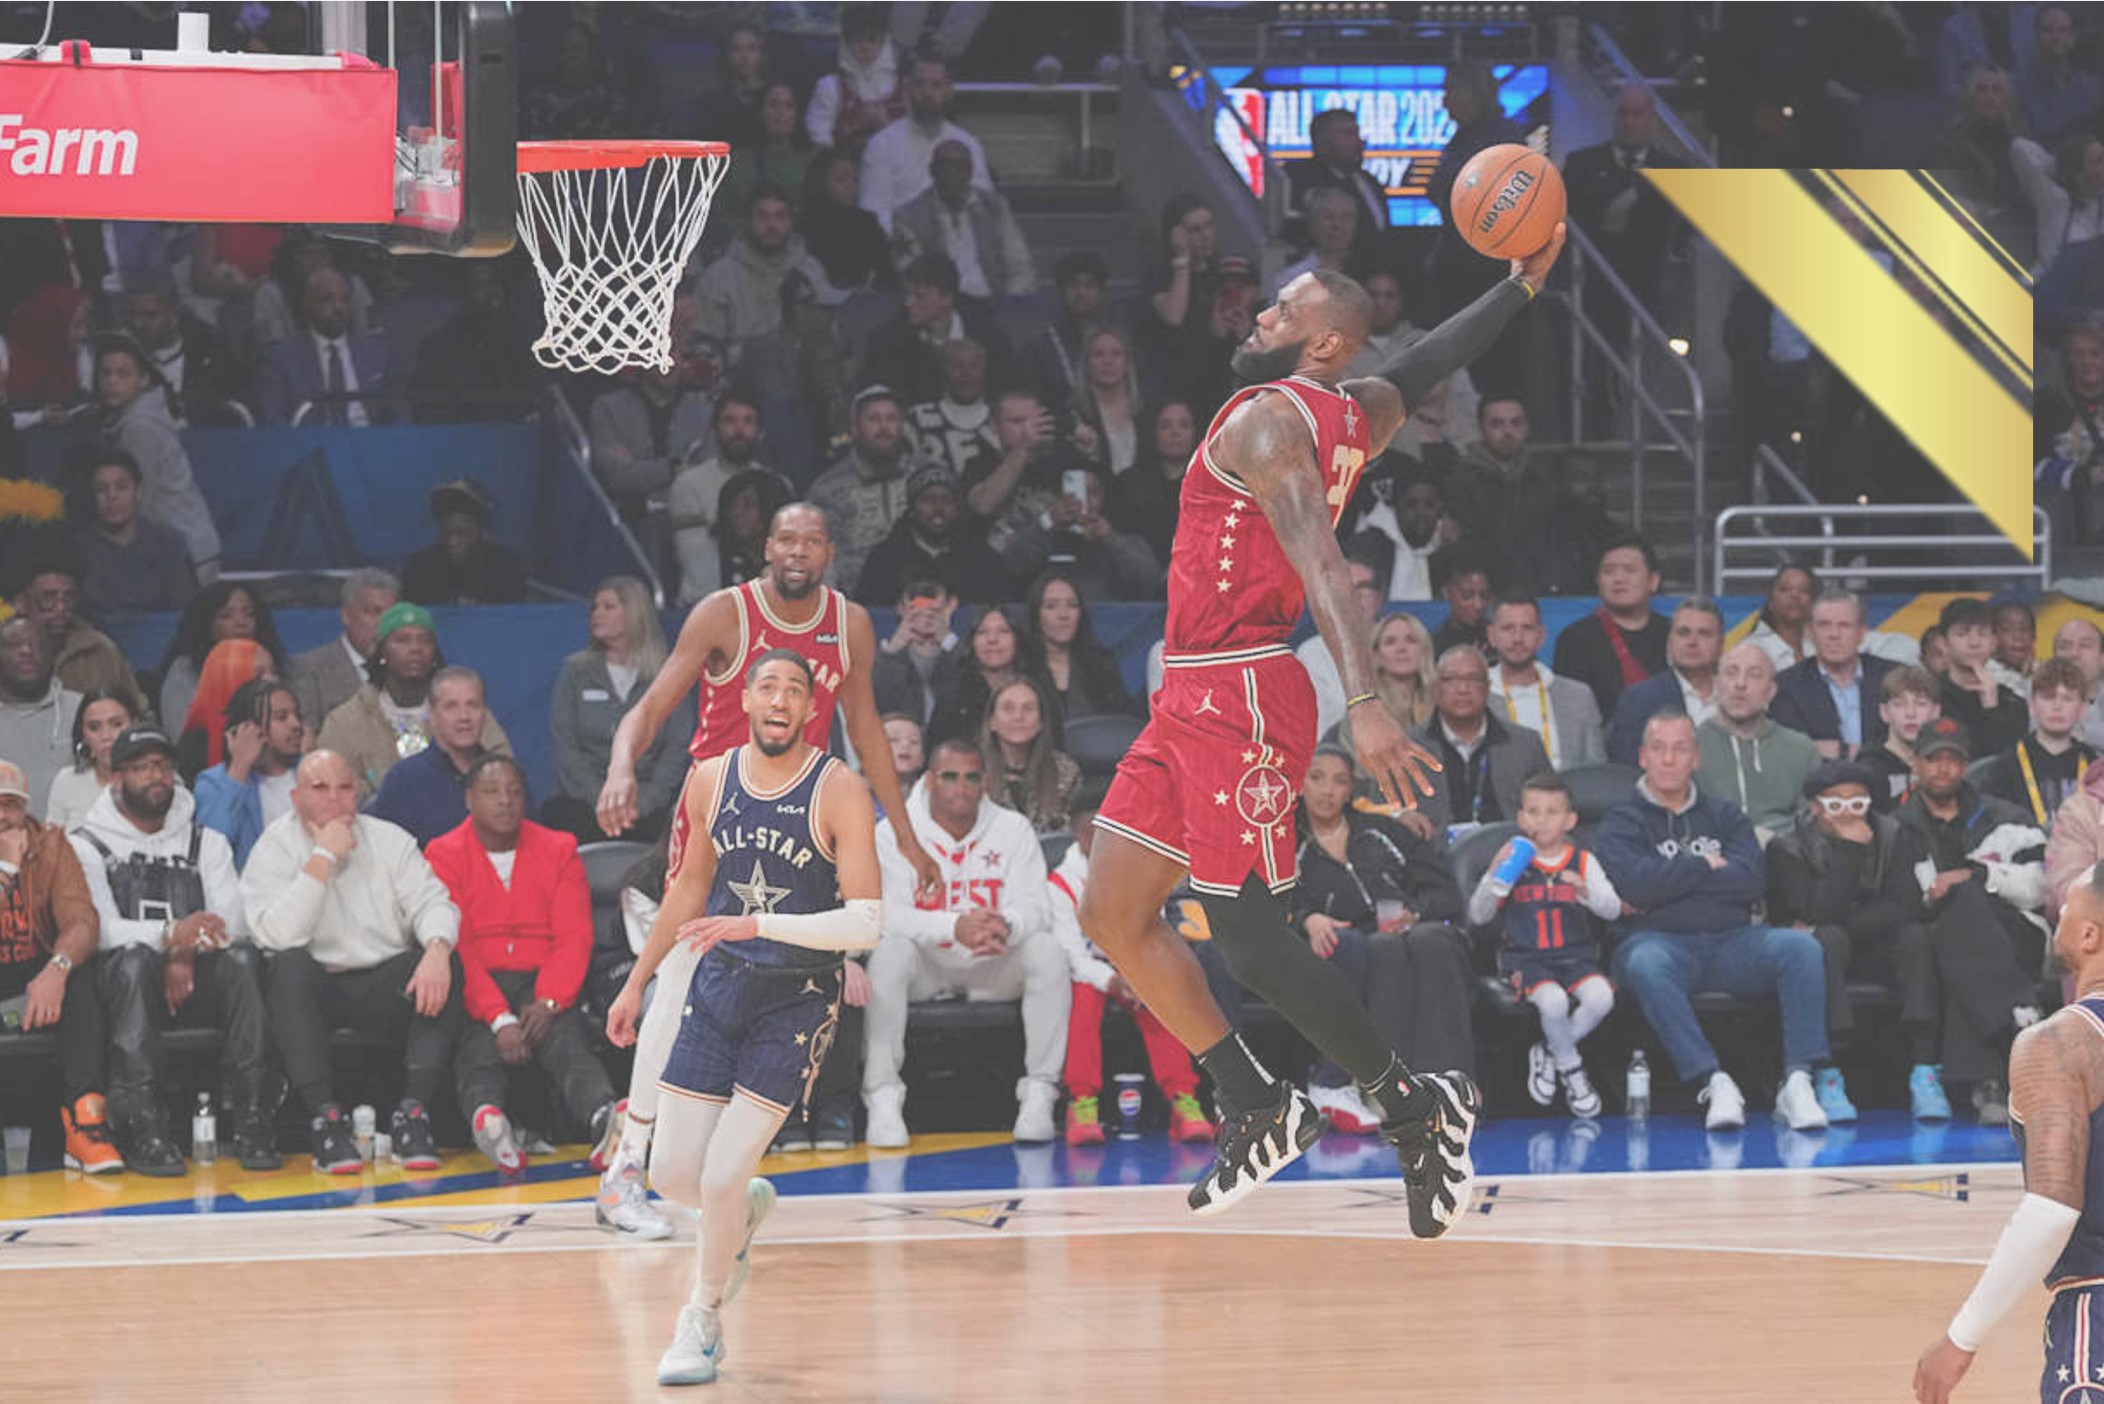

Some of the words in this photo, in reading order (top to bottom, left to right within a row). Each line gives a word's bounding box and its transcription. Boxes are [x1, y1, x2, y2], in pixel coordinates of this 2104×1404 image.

[1480, 169, 1535, 233] Wilson
[712, 825, 813, 869] ALL-STAR
[1536, 908, 1565, 950] 11
